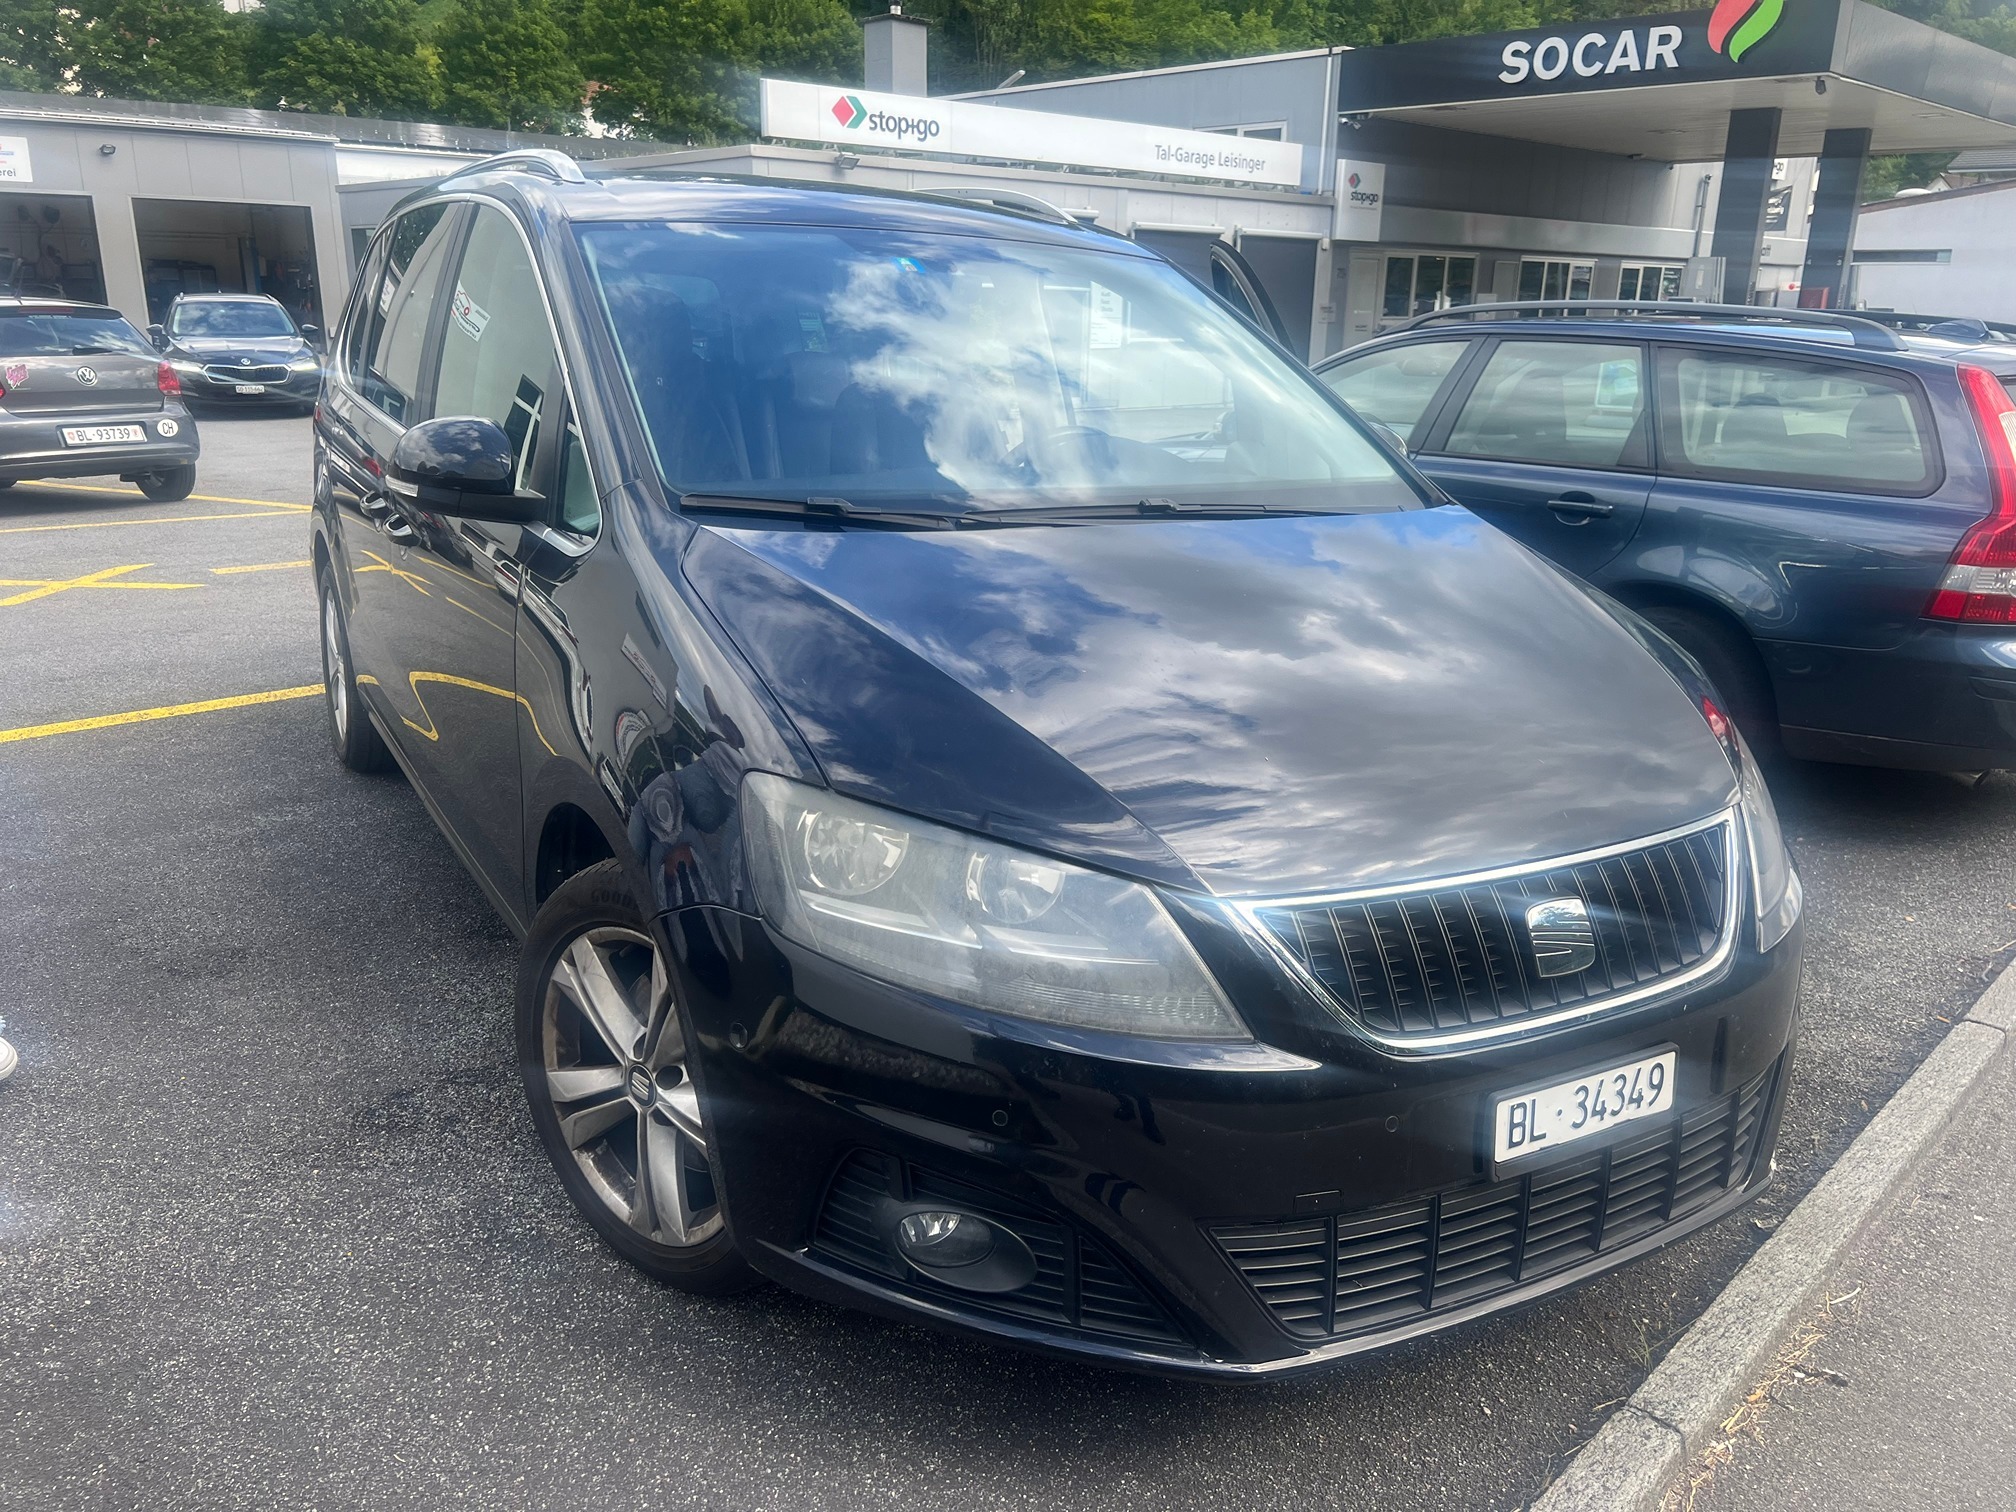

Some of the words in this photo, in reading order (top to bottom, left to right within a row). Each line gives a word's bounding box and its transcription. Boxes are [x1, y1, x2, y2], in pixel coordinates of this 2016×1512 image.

[1498, 25, 1682, 84] SOCAR
[868, 110, 940, 142] stop+go
[1154, 144, 1215, 169] Tal-Garage
[1218, 151, 1266, 173] Leisinger
[162, 423, 174, 434] CH
